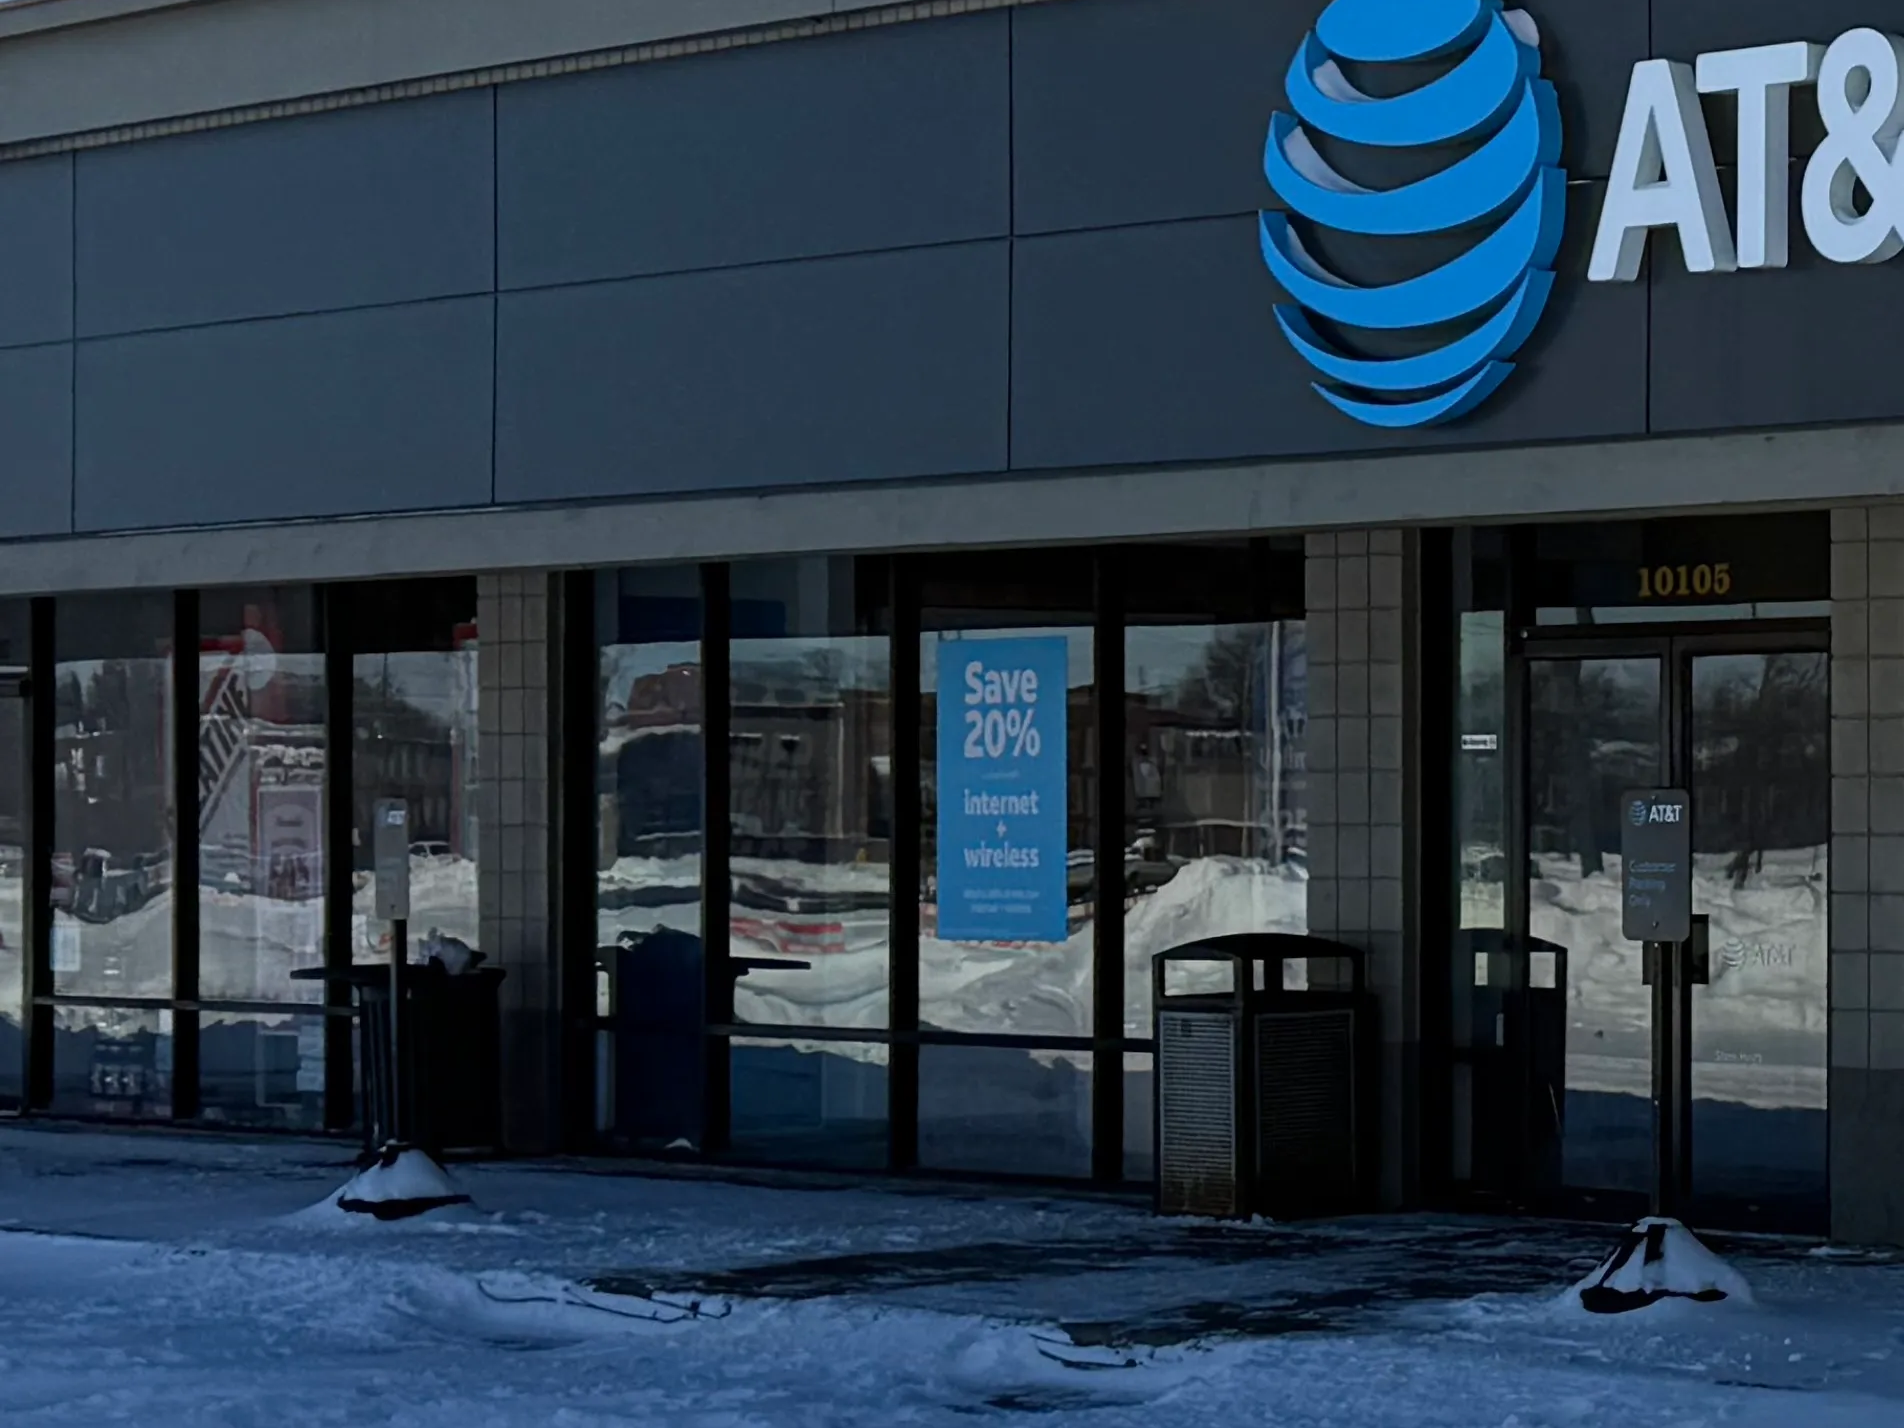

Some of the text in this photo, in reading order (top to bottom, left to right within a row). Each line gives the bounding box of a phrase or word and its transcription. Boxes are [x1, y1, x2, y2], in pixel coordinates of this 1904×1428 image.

[1638, 562, 1731, 597] 10105
[963, 661, 1038, 706] Save
[963, 708, 1041, 758] 20%
[963, 788, 1039, 816] internet
[1649, 804, 1682, 823] AT&T
[963, 839, 1040, 869] wireless
